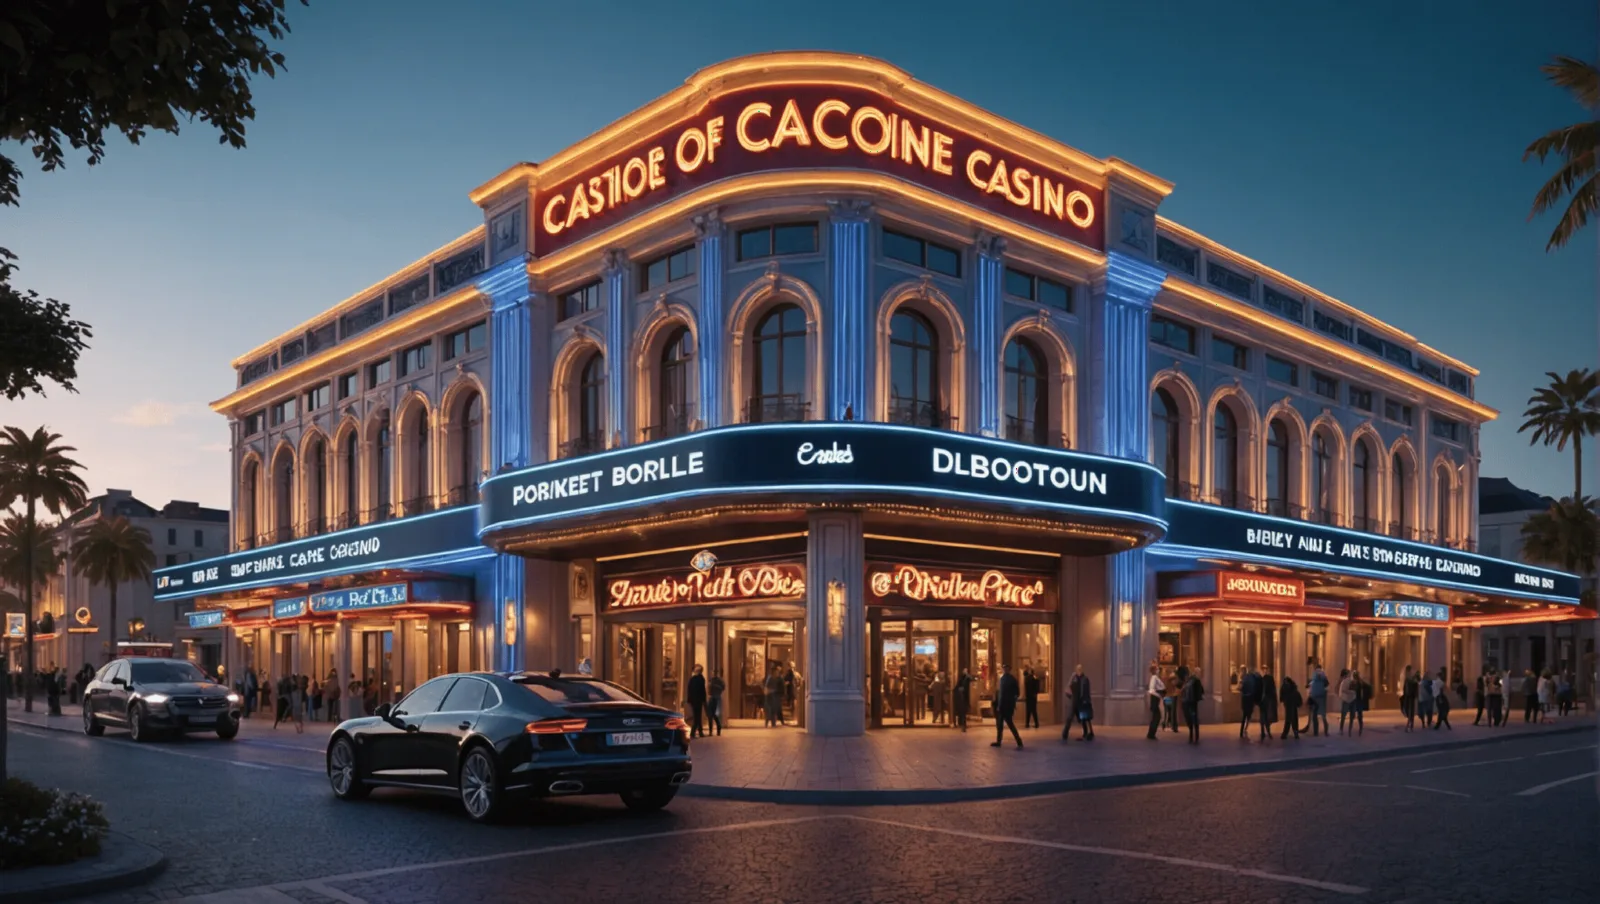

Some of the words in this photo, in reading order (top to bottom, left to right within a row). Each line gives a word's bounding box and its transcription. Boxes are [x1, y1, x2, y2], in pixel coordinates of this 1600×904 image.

[675, 116, 724, 173] OF
[965, 150, 1095, 228] CASINO
[611, 451, 704, 487] BORLLE
[932, 447, 1107, 495] DLBOOTOUN
